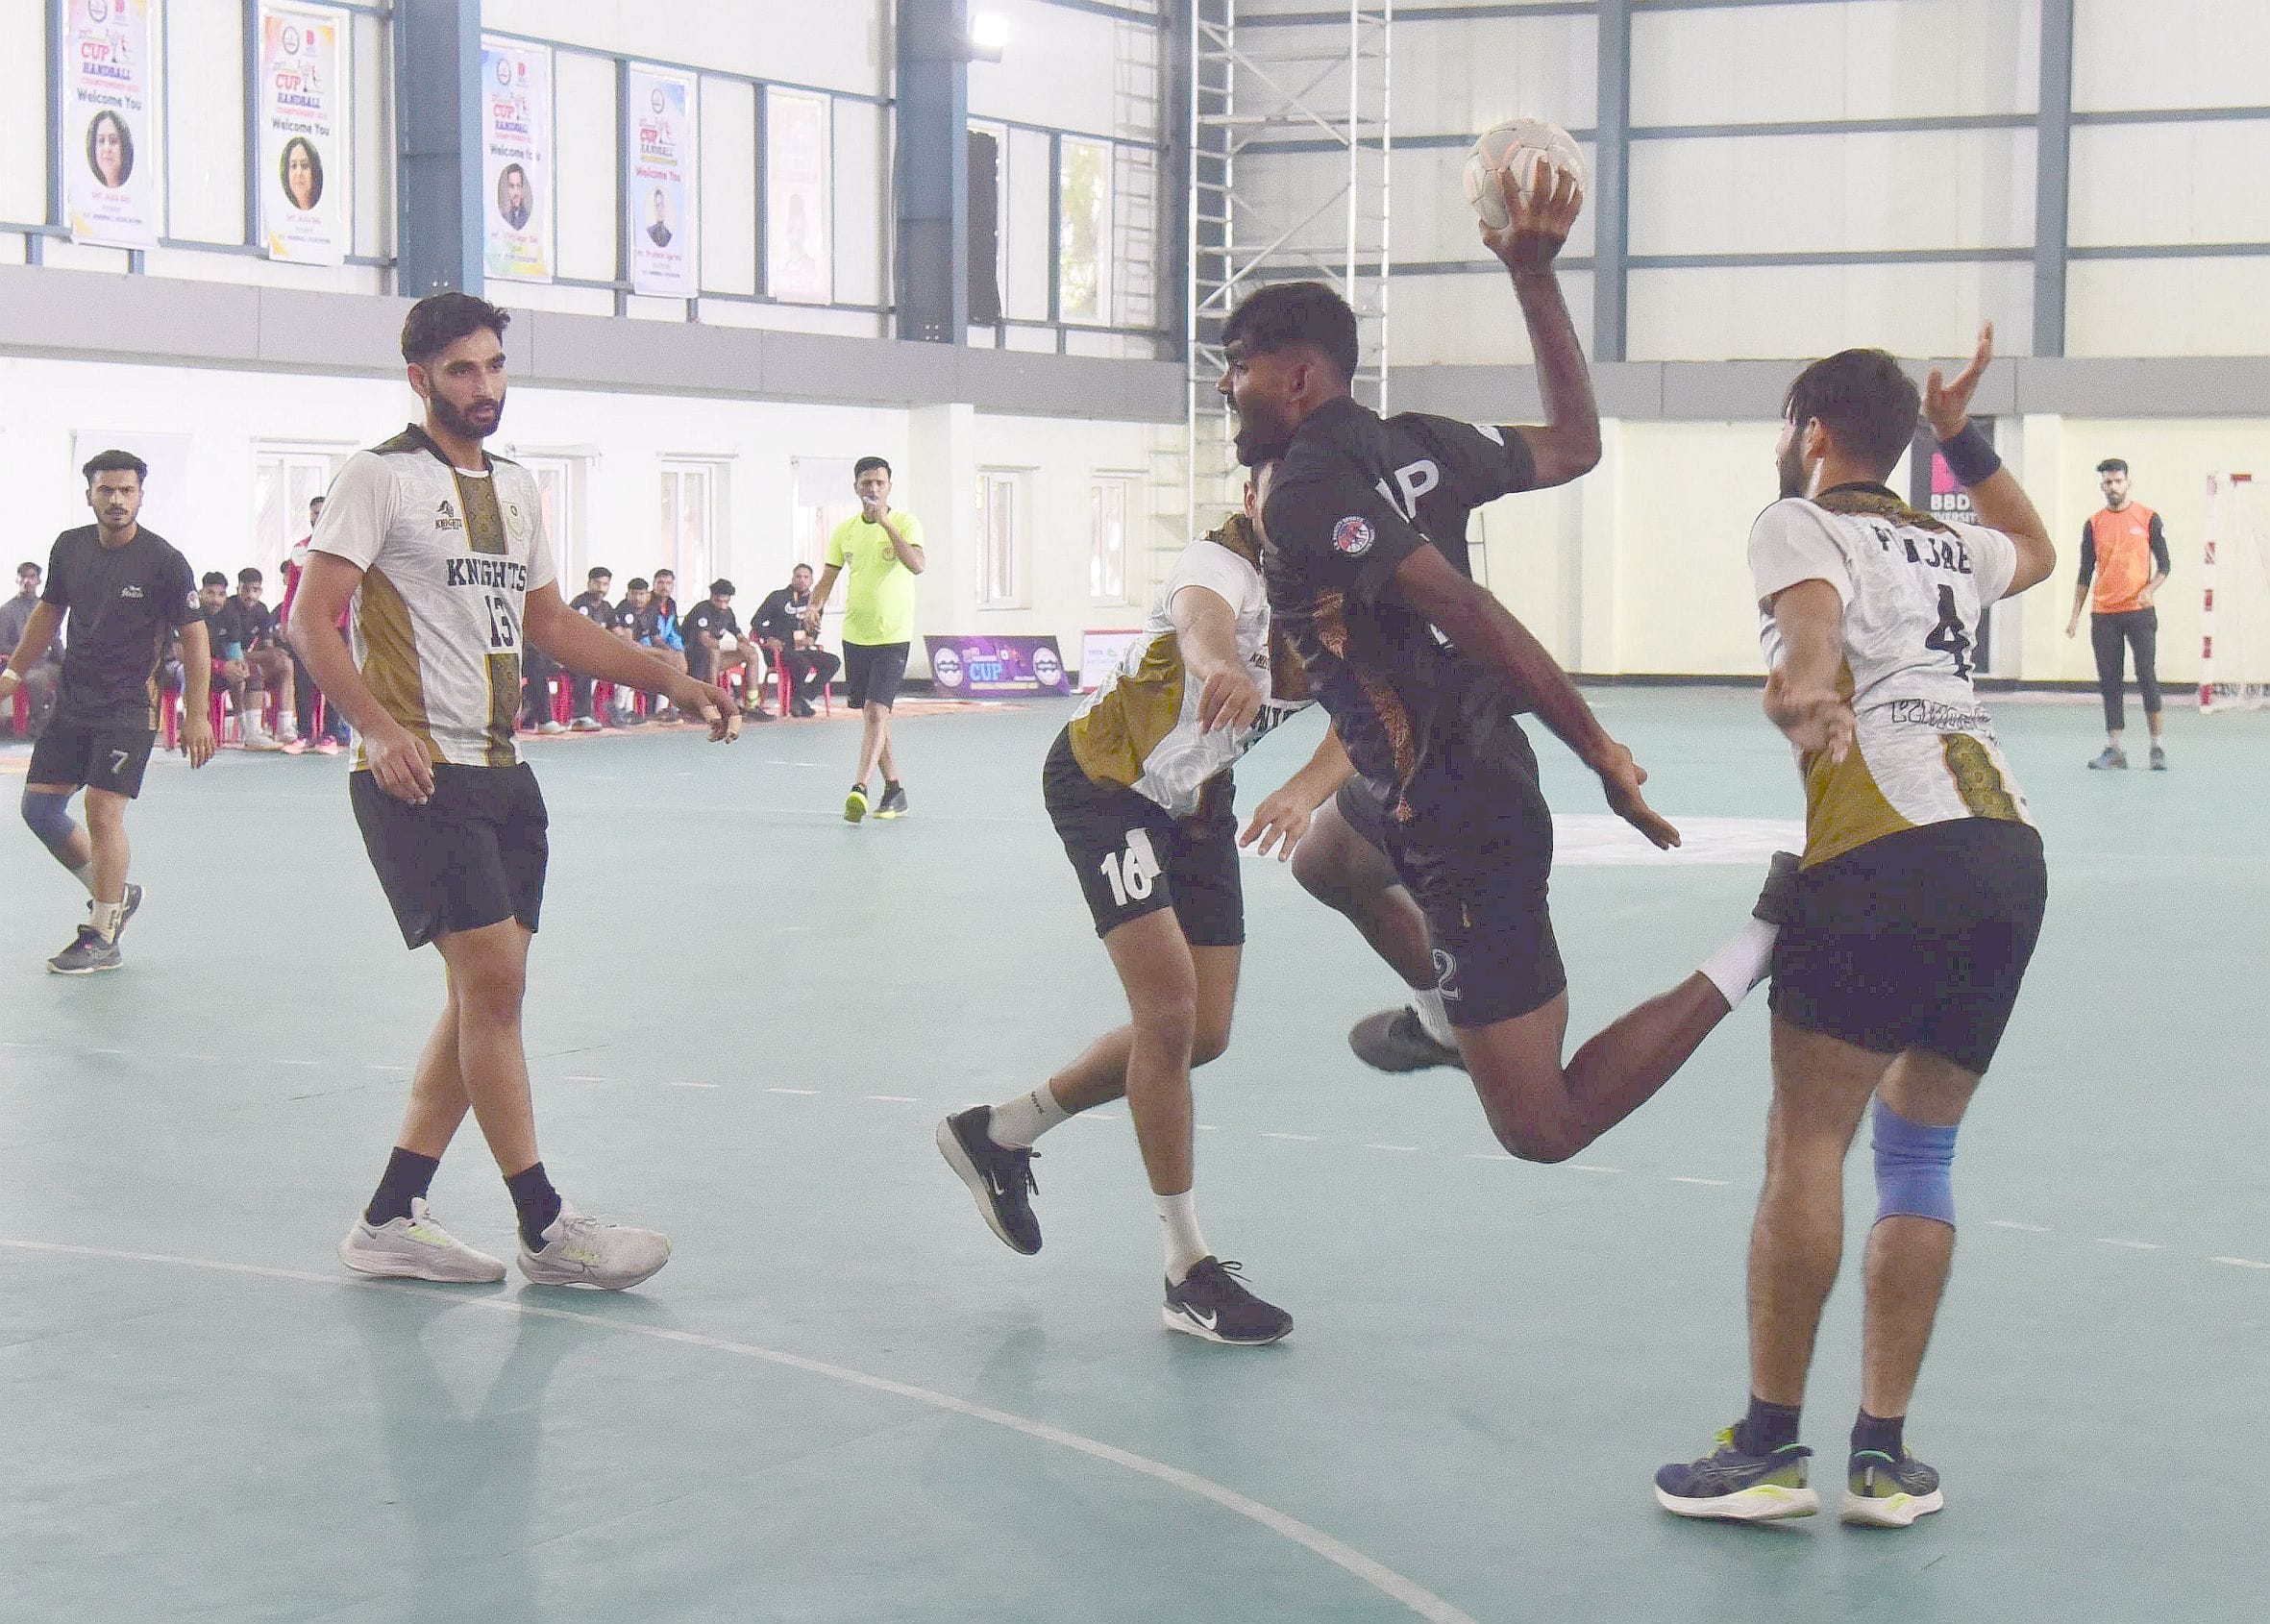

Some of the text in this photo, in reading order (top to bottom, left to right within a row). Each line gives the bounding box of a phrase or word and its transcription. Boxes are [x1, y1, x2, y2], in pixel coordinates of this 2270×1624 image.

[82, 42, 109, 61] CUP
[276, 73, 302, 90] CUP
[77, 87, 122, 107] Welcome
[272, 116, 312, 134] Welcome
[1930, 493, 1971, 511] BBD
[484, 595, 514, 648] 13
[1925, 583, 1972, 682] 4
[969, 662, 1003, 682] CUP
[110, 749, 130, 775] 7
